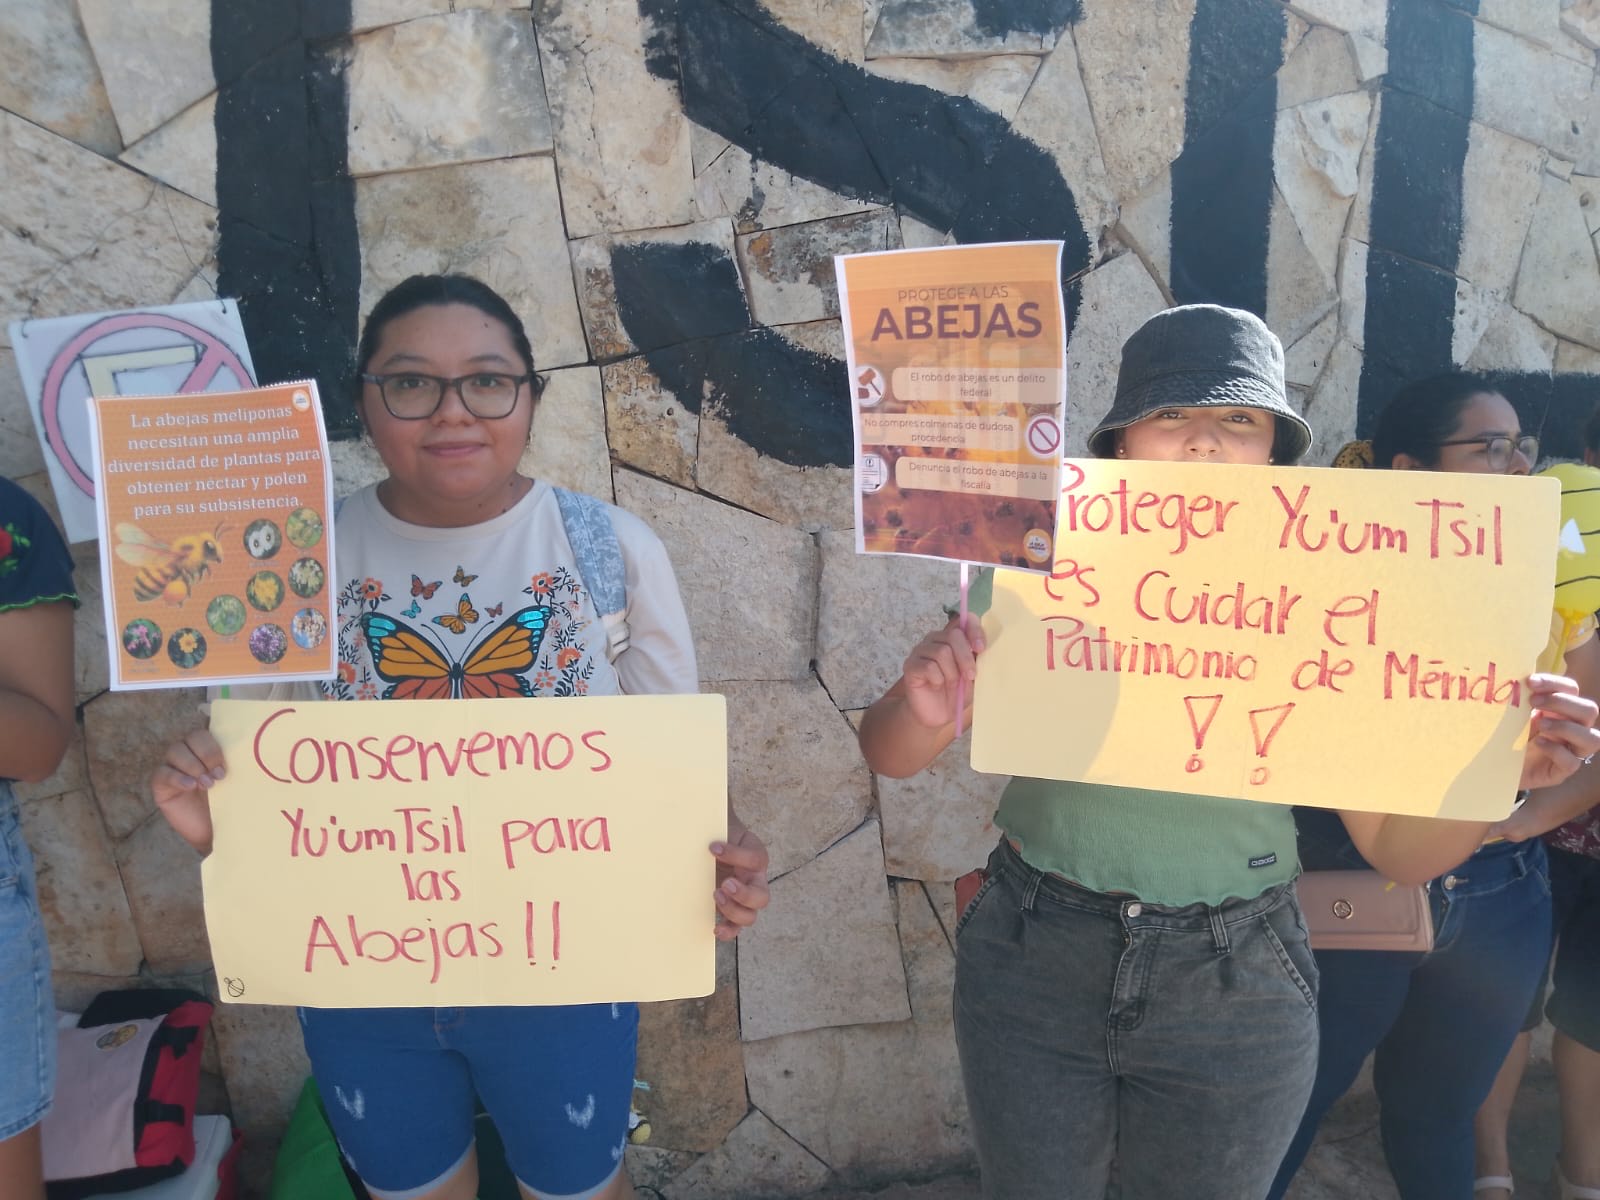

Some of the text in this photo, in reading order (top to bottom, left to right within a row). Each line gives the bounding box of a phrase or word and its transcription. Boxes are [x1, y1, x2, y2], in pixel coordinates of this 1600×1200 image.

[898, 285, 1009, 302] PROTEGE A LAS
[871, 302, 1043, 342] ABEJAS
[910, 372, 1046, 384] El robo de abejas es un delito
[960, 387, 992, 398] federal
[131, 406, 293, 428] La abejas meliponas
[864, 418, 1014, 432] No compres colmenas de dudosa
[128, 427, 299, 450] necesitan una amplia
[911, 433, 966, 444] procedencia
[108, 448, 321, 473] diversidad de plantas para
[909, 462, 1048, 480] Denuncia el robo de abejas a la
[127, 481, 191, 496] obtener
[250, 477, 259, 490] y
[264, 471, 308, 489] polen
[134, 496, 303, 520] para su subsistencia.
[1043, 558, 1101, 608] es
[1322, 588, 1380, 647] el
[1041, 615, 1257, 681] Patrimonio
[1291, 649, 1356, 694] de
[253, 707, 613, 784] Conservemos
[500, 815, 612, 869] para
[400, 862, 462, 902] las
